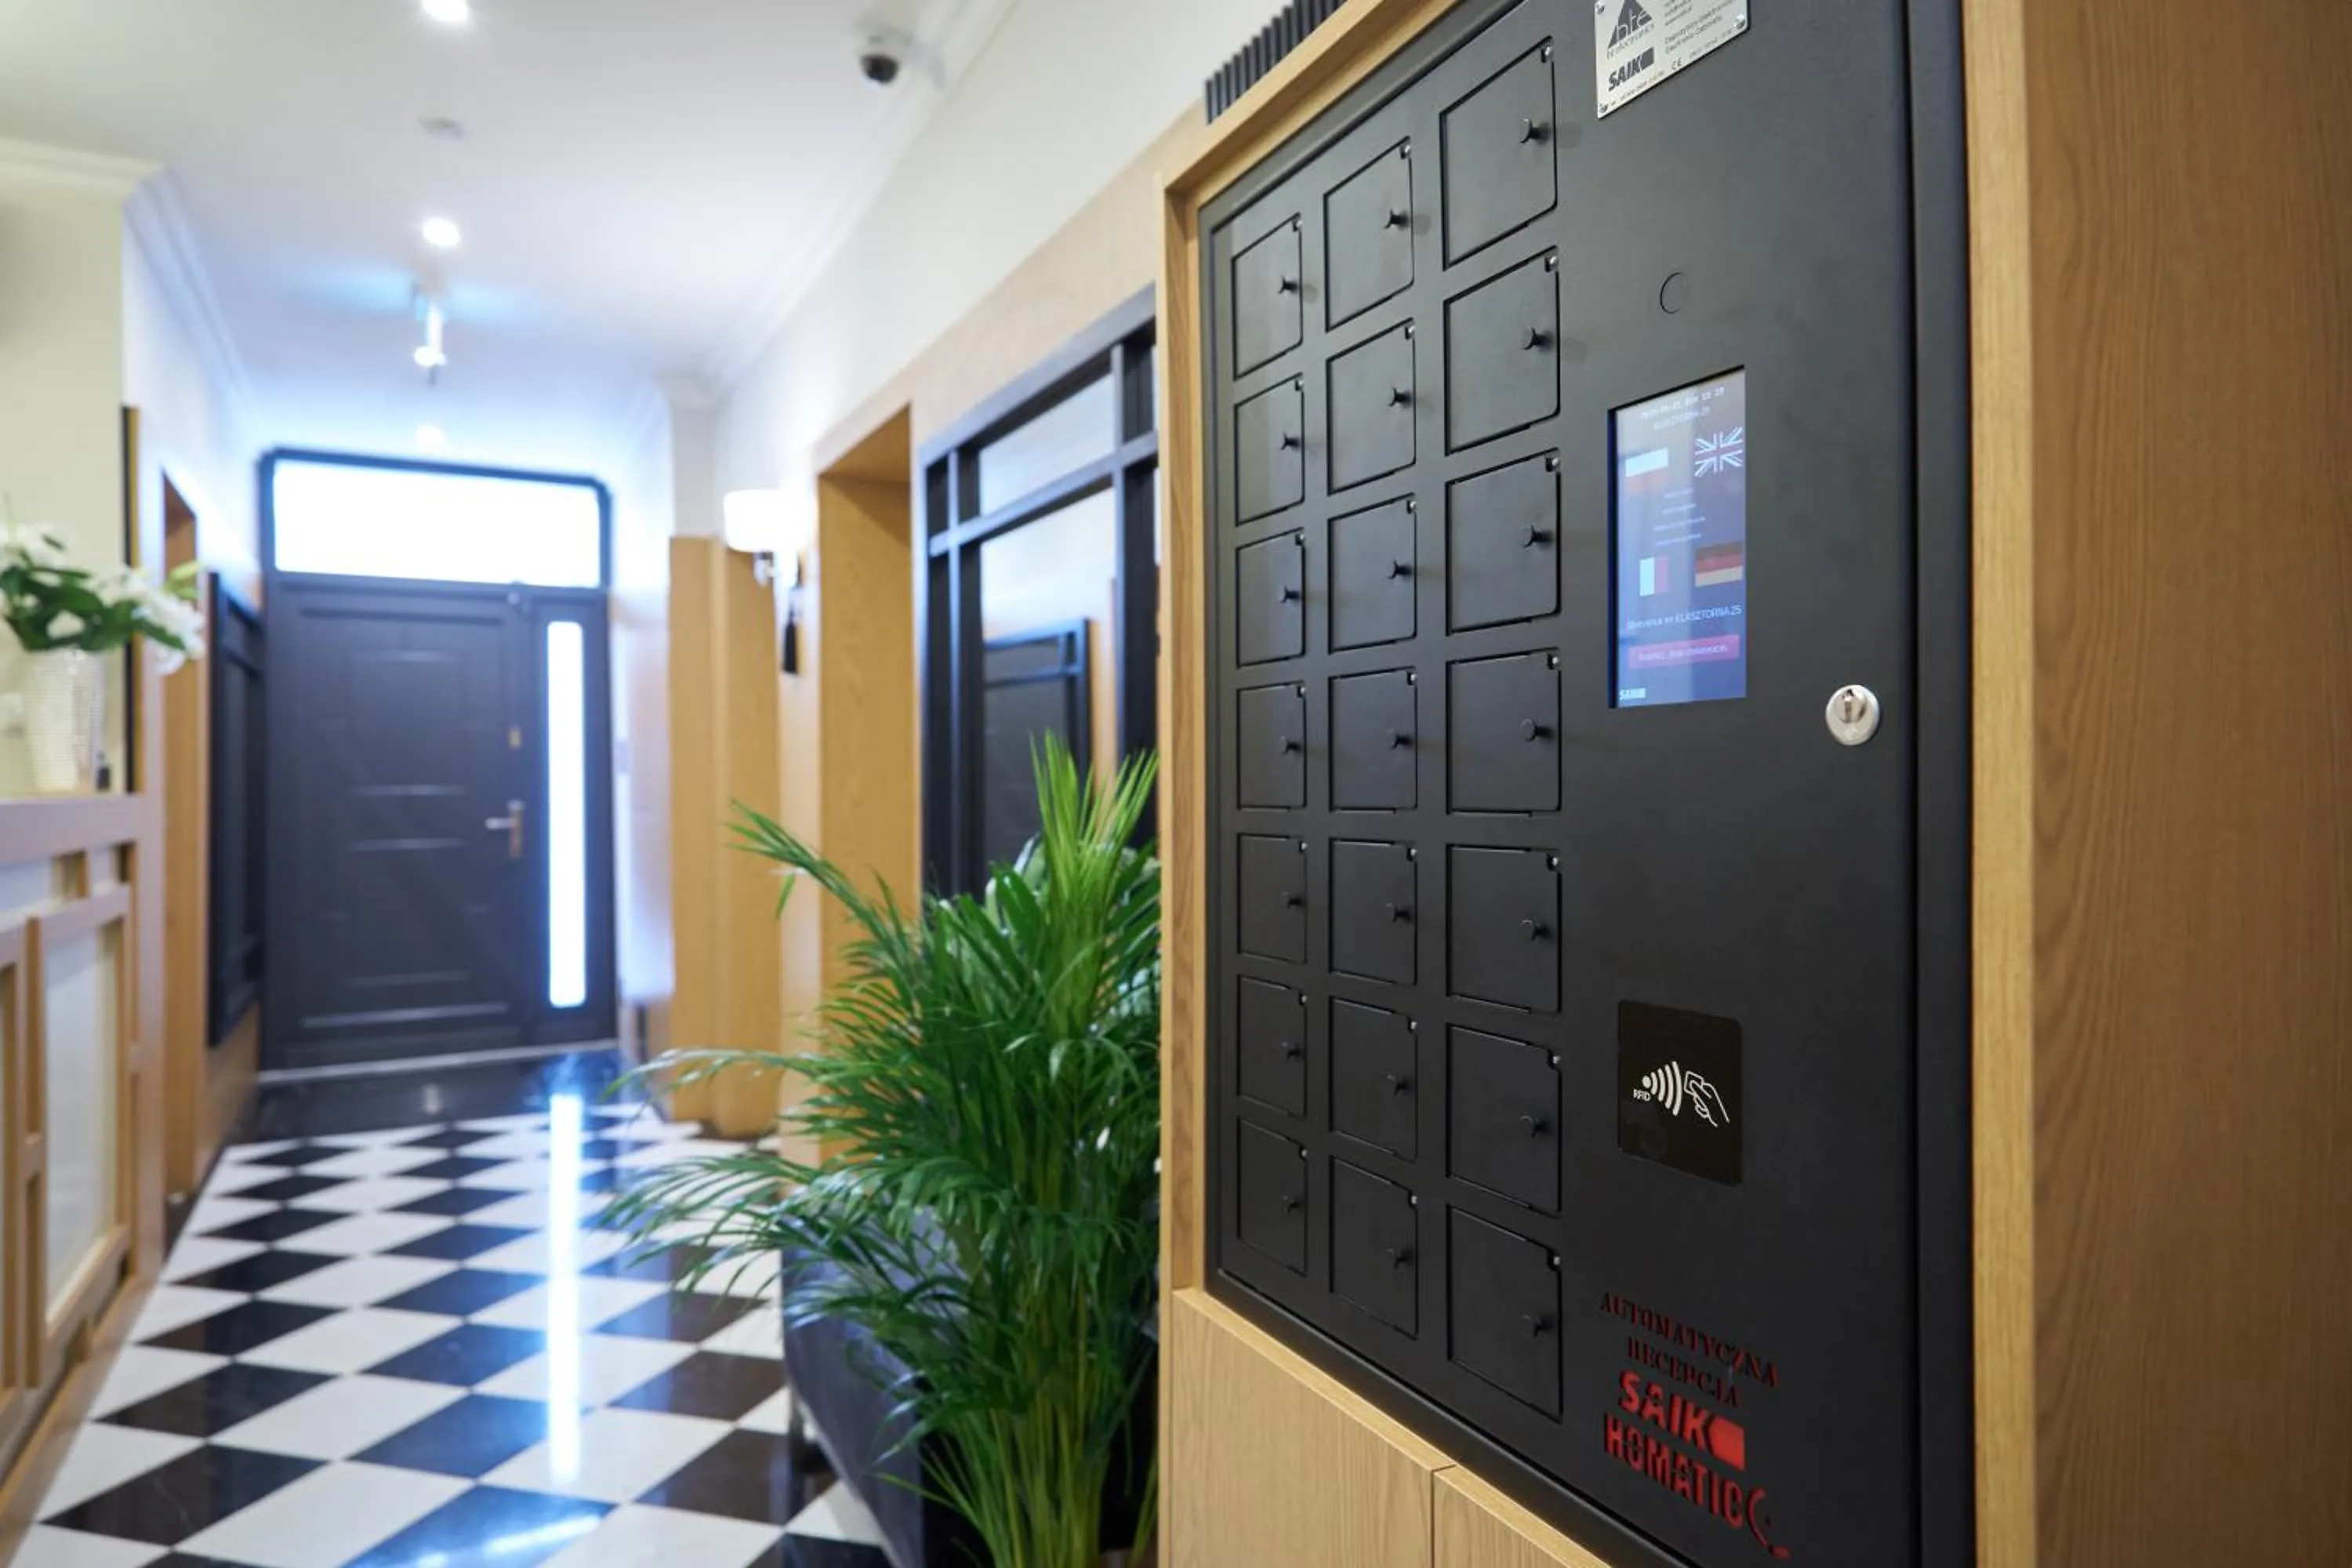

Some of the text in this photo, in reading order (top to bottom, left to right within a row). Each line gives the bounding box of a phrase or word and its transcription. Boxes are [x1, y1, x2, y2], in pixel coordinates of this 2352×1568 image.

[1608, 55, 1642, 92] SAIK
[1633, 1089, 1650, 1102] RFID
[1602, 1292, 1778, 1388] AUTOMATYCZNA
[1619, 1371, 1707, 1451] SAIK
[1605, 1413, 1744, 1530] HOMATIC
